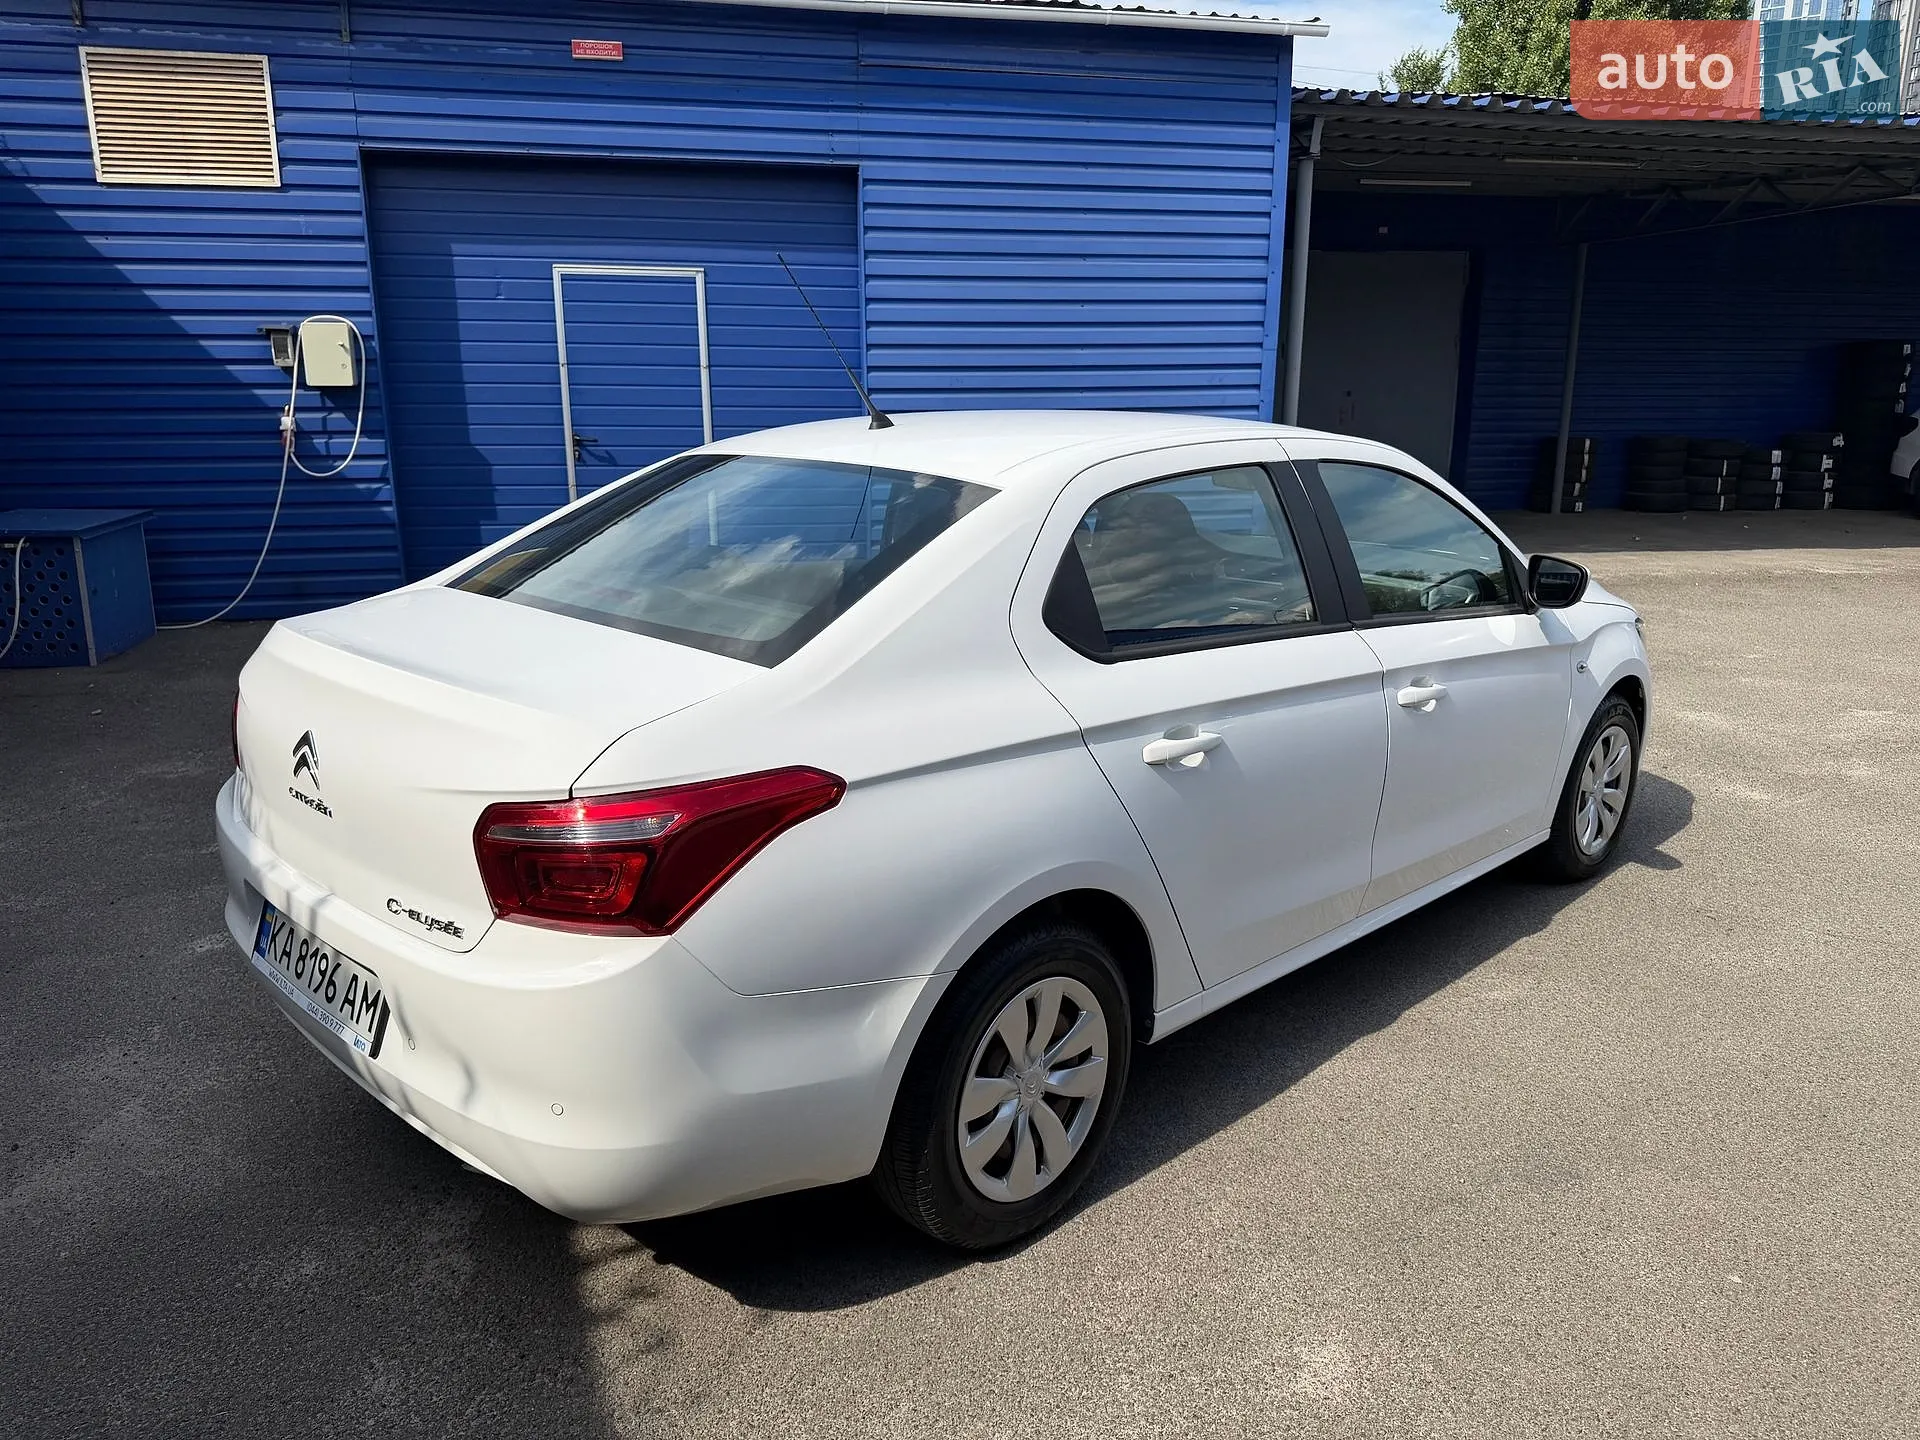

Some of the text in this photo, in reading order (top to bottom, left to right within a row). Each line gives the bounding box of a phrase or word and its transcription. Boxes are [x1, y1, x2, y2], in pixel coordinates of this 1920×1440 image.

[580, 42, 614, 50] ПОРОШОК
[268, 914, 382, 1034] KA 8196 AM
